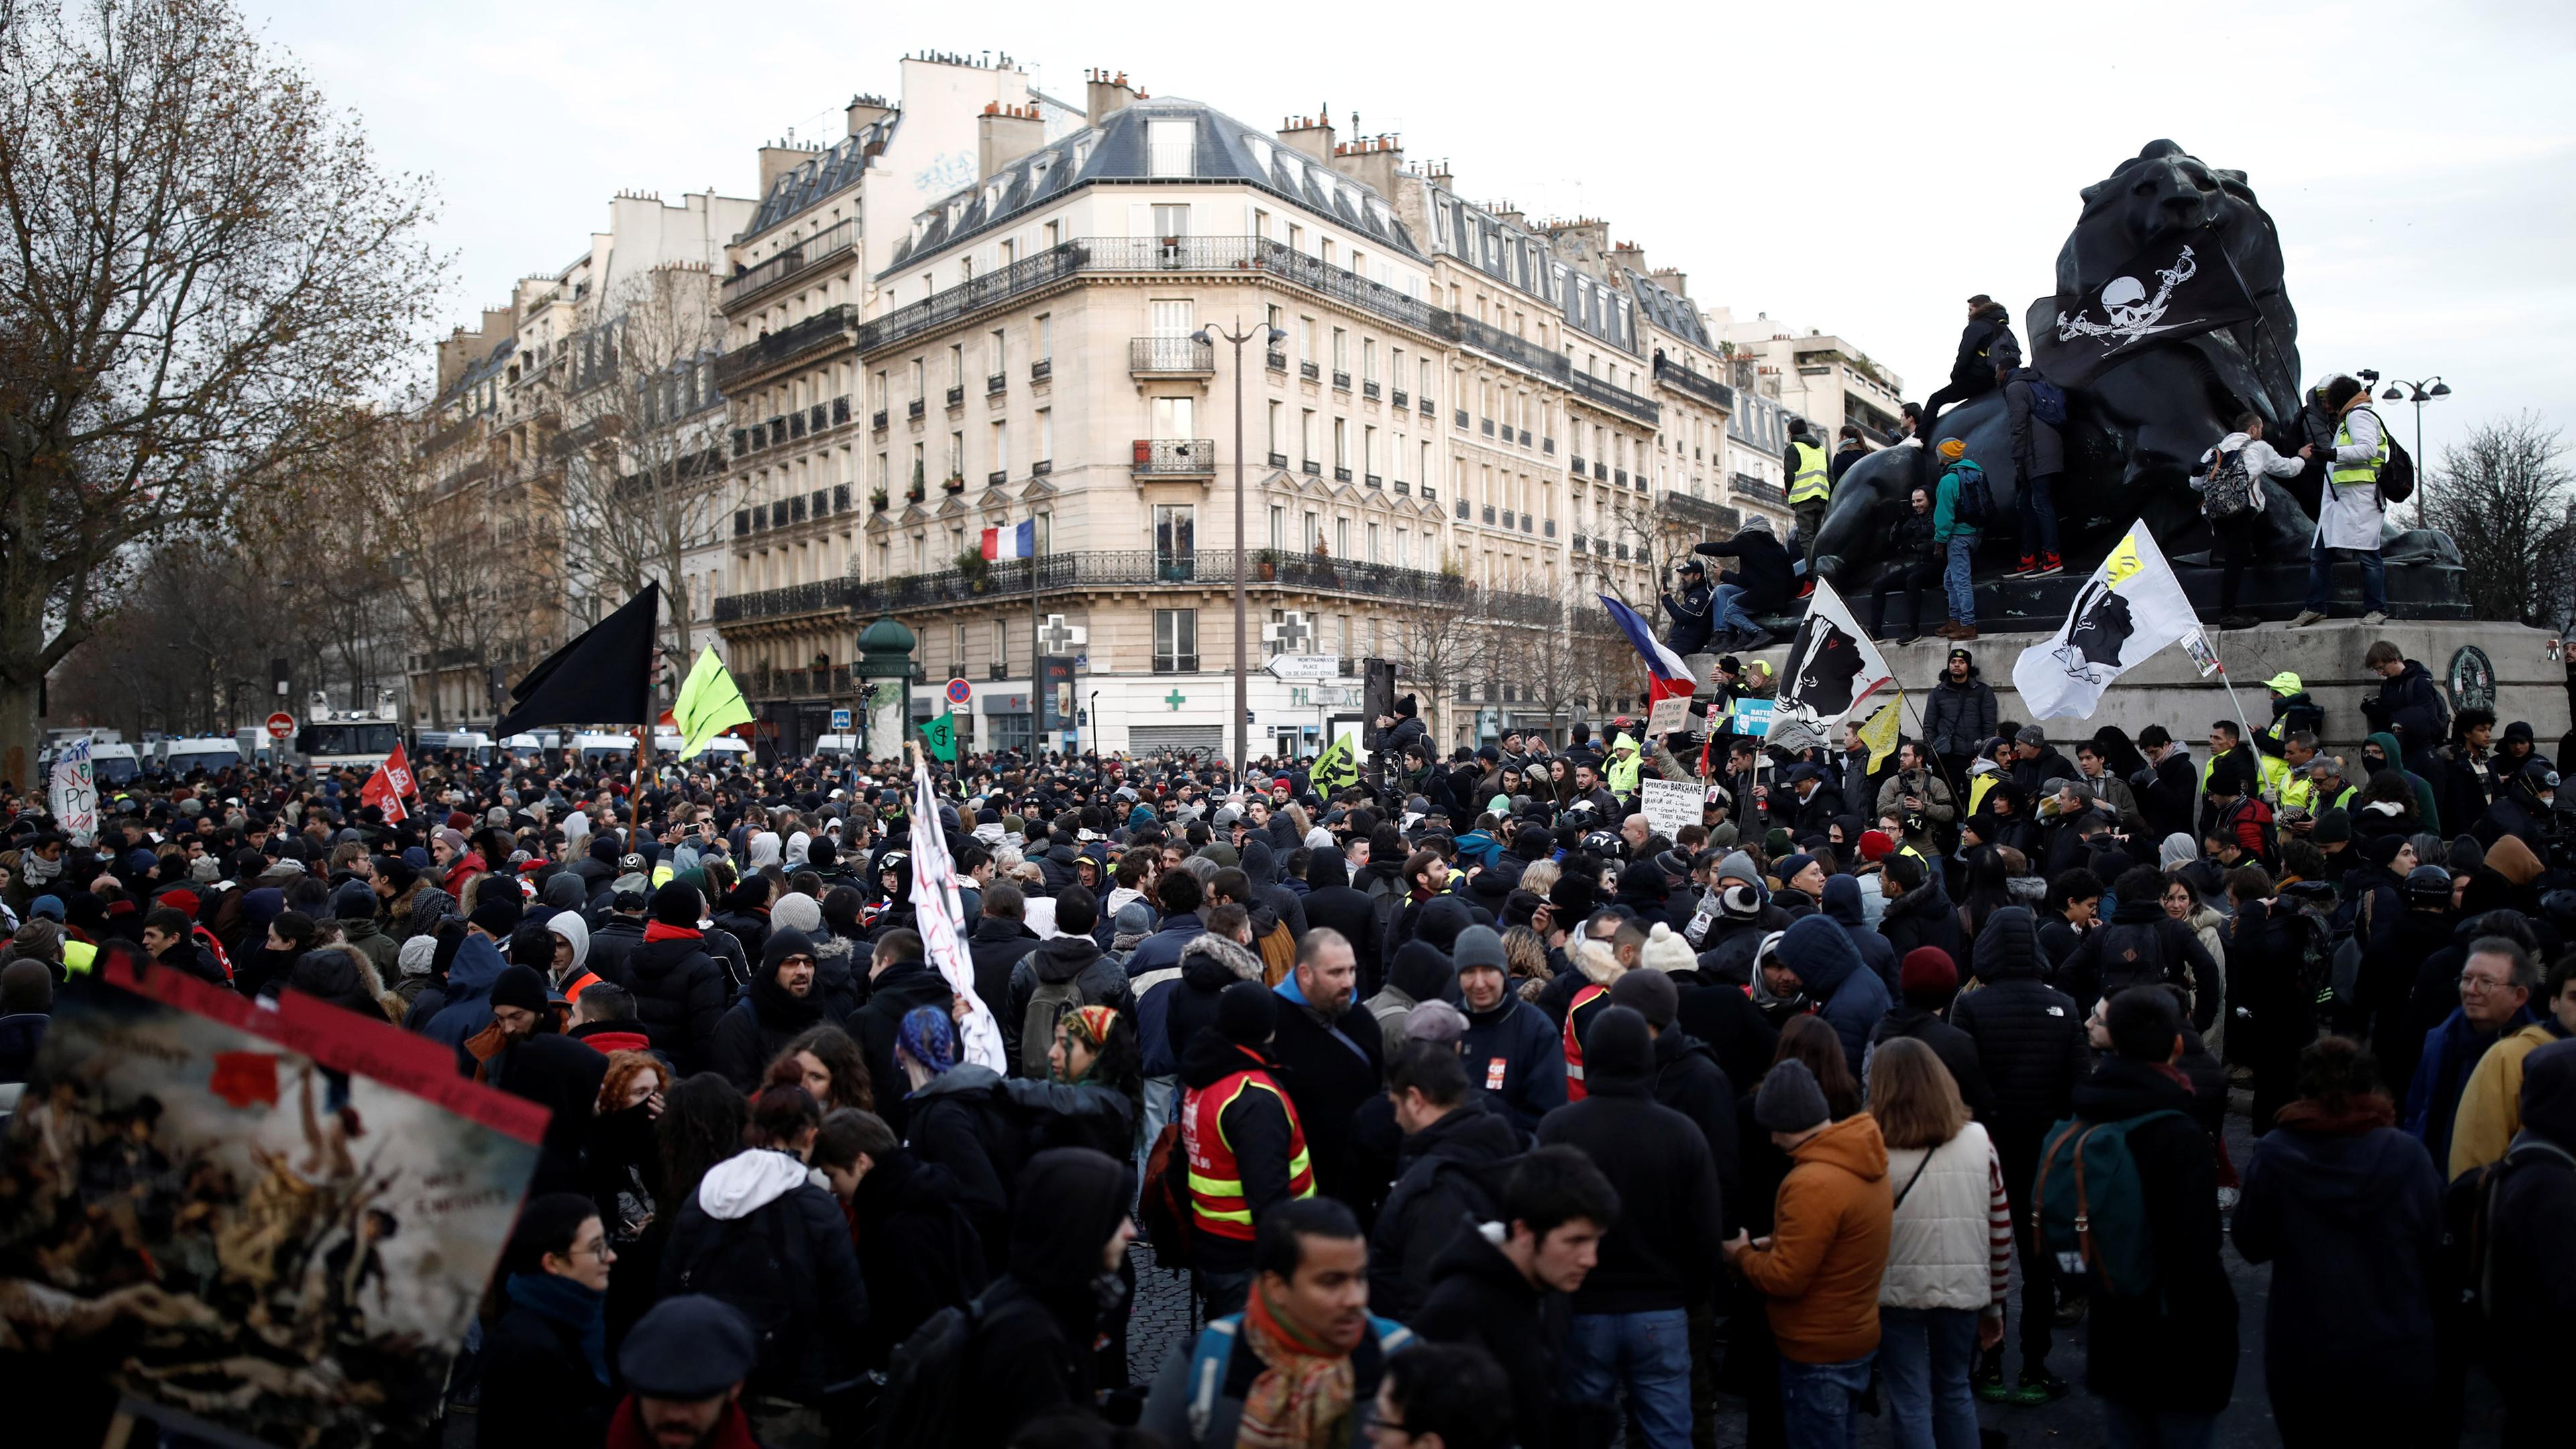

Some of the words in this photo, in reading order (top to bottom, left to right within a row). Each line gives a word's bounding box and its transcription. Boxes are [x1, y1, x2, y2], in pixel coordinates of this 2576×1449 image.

[1750, 716, 1771, 724] RETRA
[1646, 781, 1669, 790] OPERATION
[1670, 783, 1703, 796] BARKHANE
